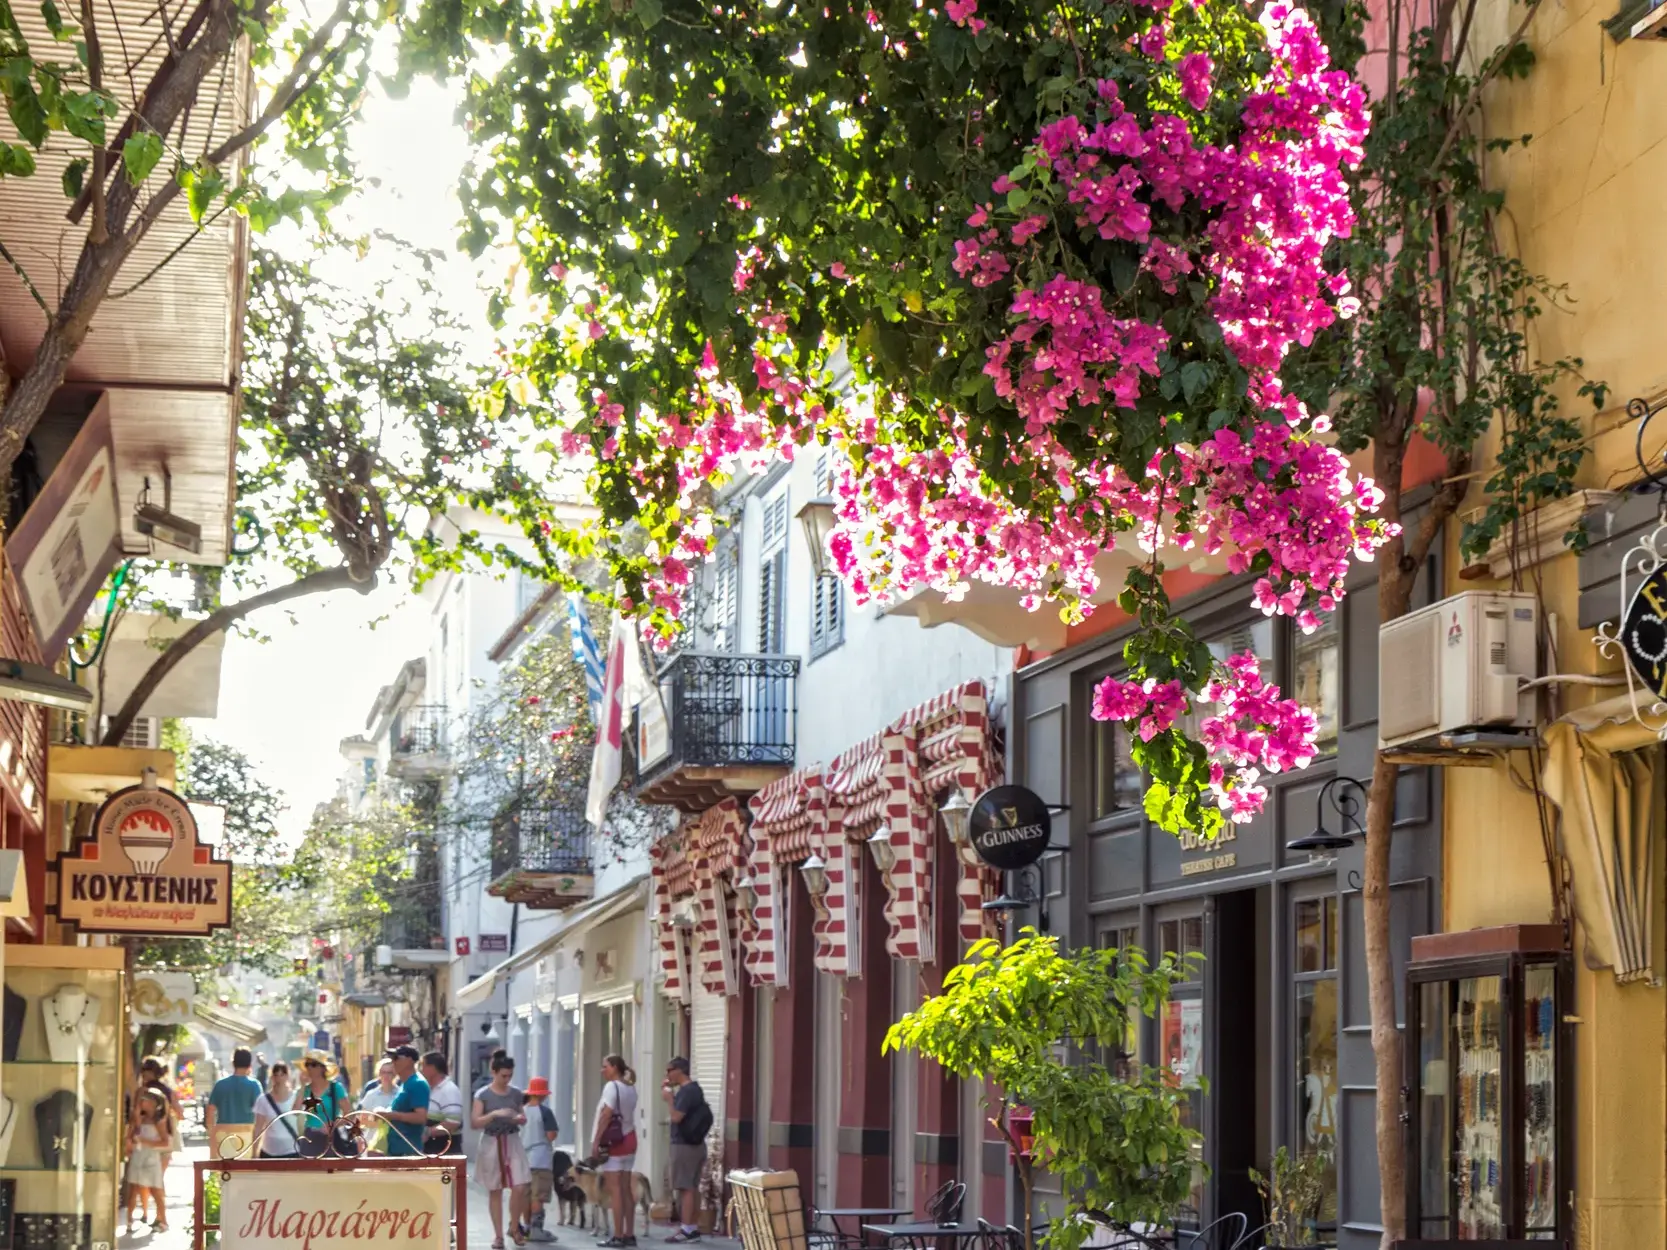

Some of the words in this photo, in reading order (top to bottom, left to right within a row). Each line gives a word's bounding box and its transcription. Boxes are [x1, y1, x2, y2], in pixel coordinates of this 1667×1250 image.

[982, 824, 1044, 848] GUINNESS
[72, 873, 218, 905] ΚΟΥΣΤΕΝΗΣ
[239, 1198, 435, 1250] Μαριάννα
